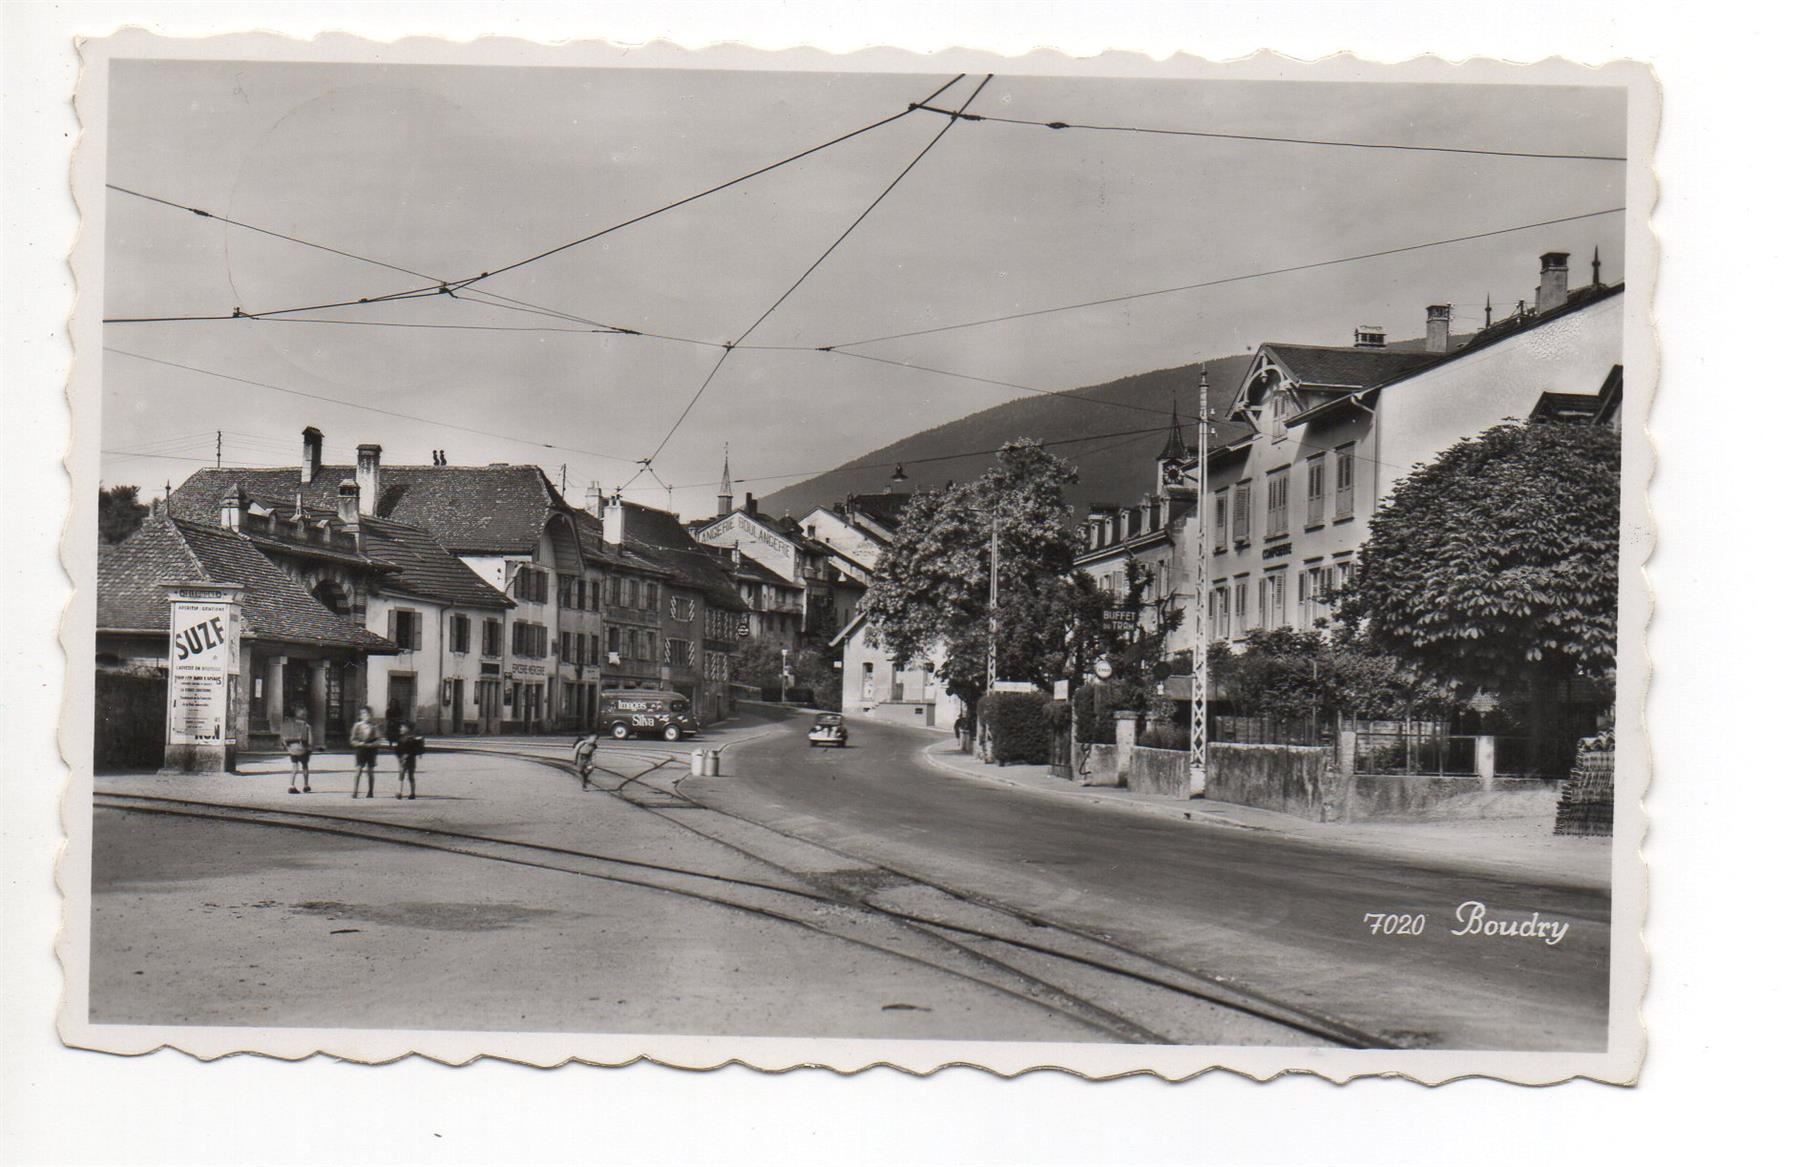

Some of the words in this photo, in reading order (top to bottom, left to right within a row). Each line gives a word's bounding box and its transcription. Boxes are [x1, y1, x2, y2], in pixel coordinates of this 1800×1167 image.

[738, 516, 792, 558] BOULANGERIE
[1103, 610, 1136, 621] BUFFET
[1112, 621, 1135, 631] TRAM
[176, 616, 224, 660] SUZE
[618, 700, 647, 711] Images
[632, 714, 655, 727] Silva
